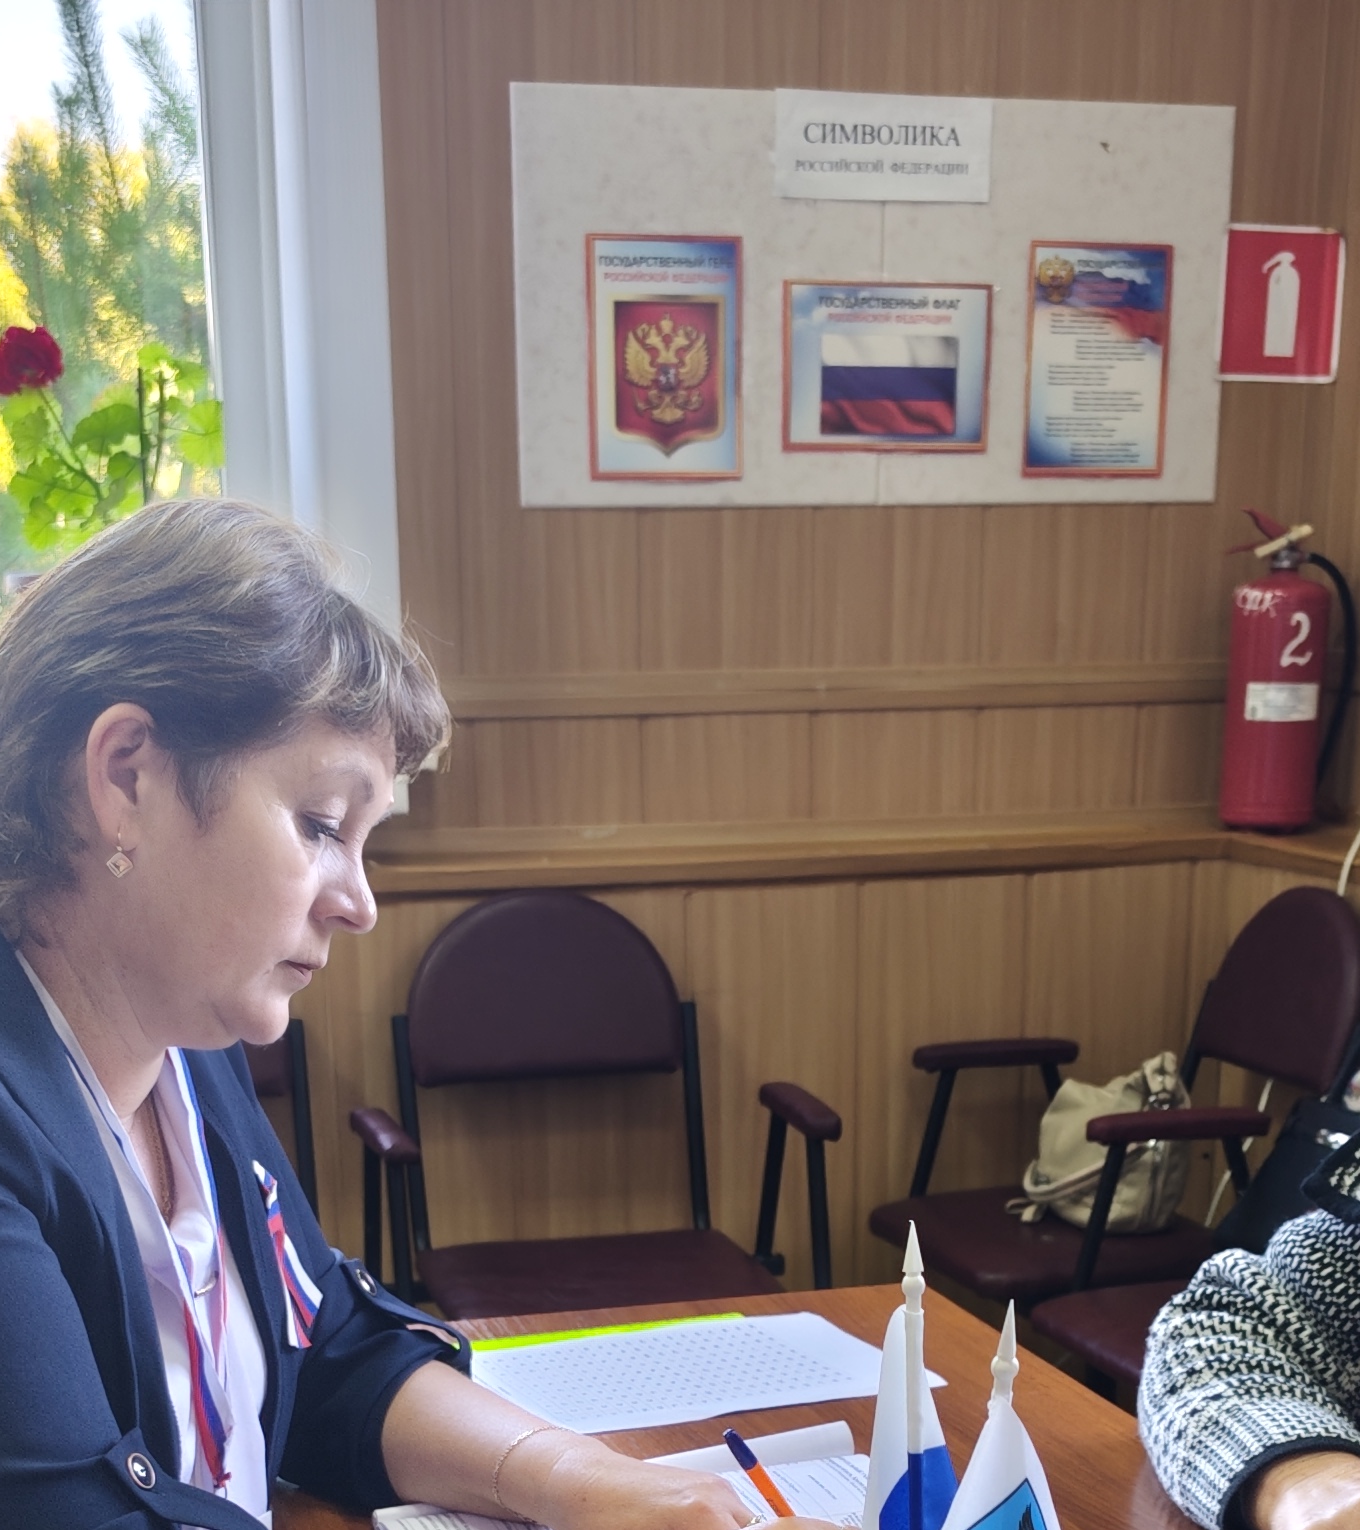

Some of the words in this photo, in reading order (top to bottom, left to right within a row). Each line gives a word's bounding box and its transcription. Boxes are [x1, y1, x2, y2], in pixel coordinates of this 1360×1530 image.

[803, 122, 961, 147] СИМВОЛИКА
[795, 159, 884, 174] РОССИЙСКОЙ
[890, 161, 969, 176] ФЕДЕРАЦИИ
[1280, 611, 1313, 667] 2
